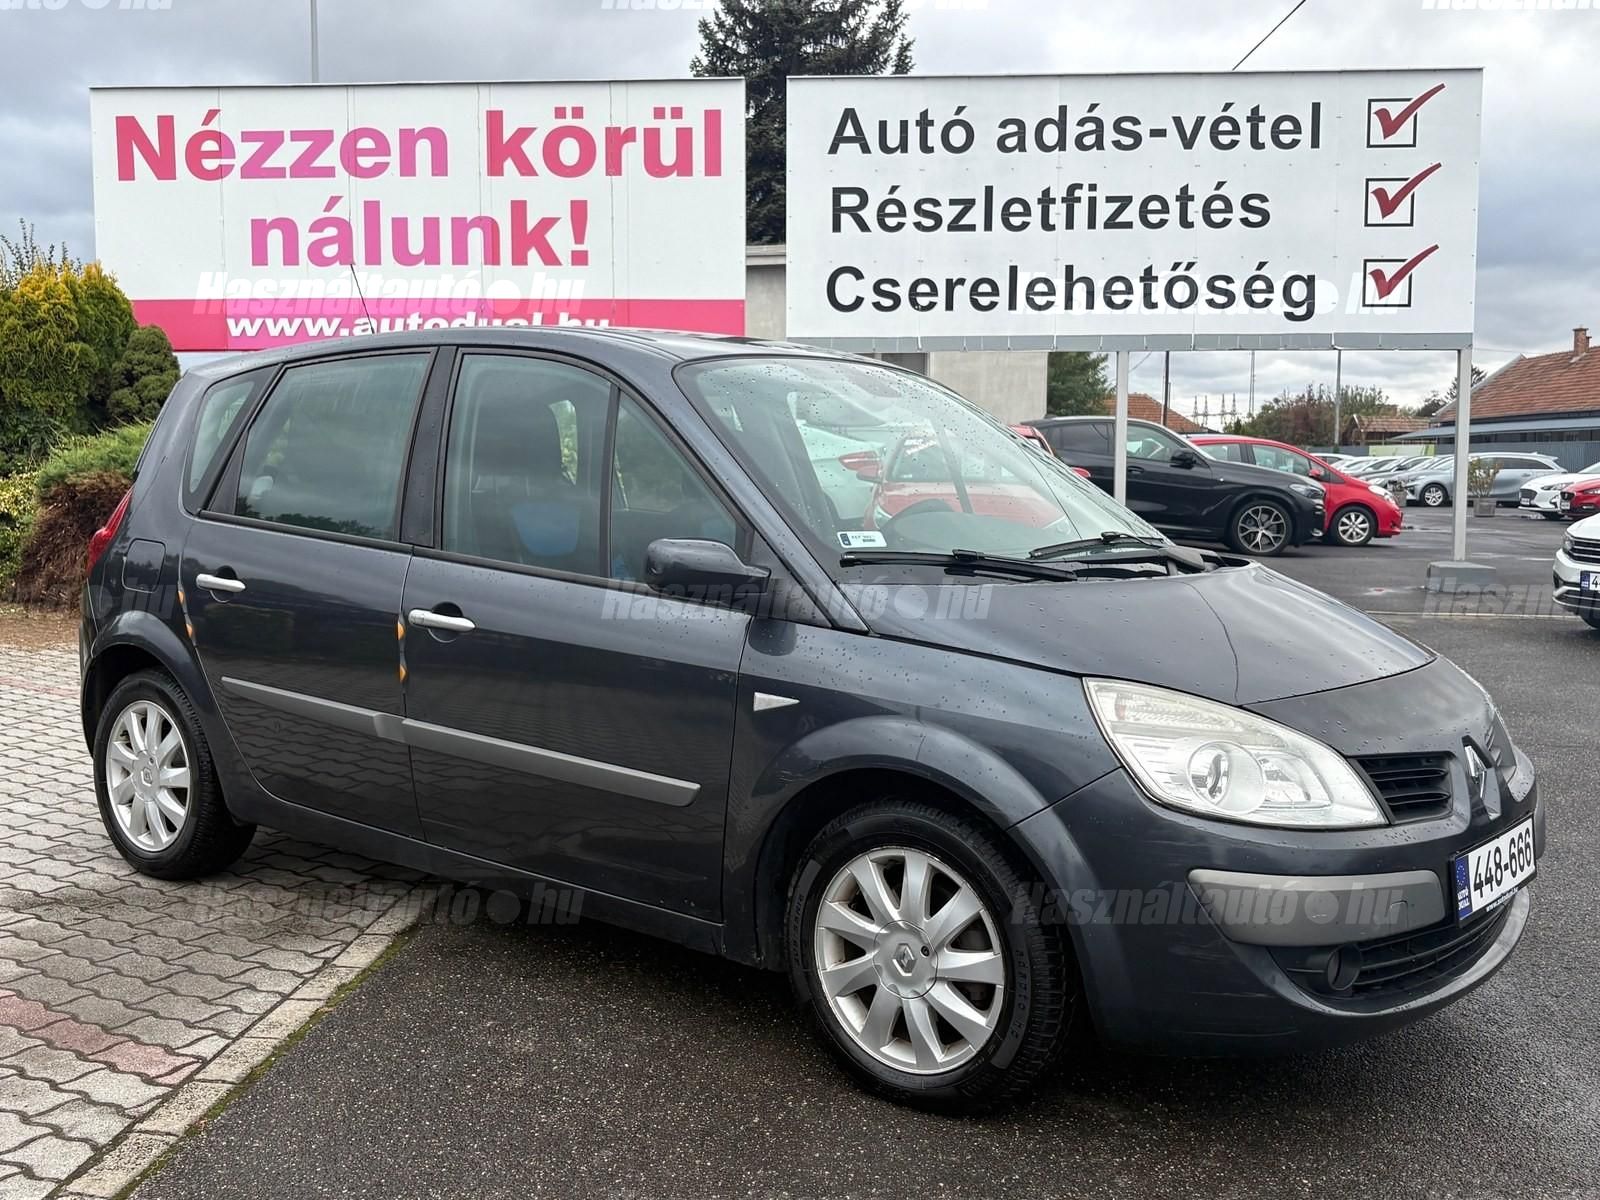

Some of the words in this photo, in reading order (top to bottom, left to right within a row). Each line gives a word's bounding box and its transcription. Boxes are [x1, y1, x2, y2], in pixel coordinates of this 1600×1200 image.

[115, 108, 449, 182] Nézzen
[485, 105, 722, 179] körül
[827, 105, 975, 155] Autó
[996, 102, 1321, 154] adás-vétel
[250, 195, 590, 268] nálunk!
[832, 180, 1271, 233] Részletfizetés
[826, 261, 1316, 322] Cserelehetőség
[1473, 827, 1532, 898] 448-666
